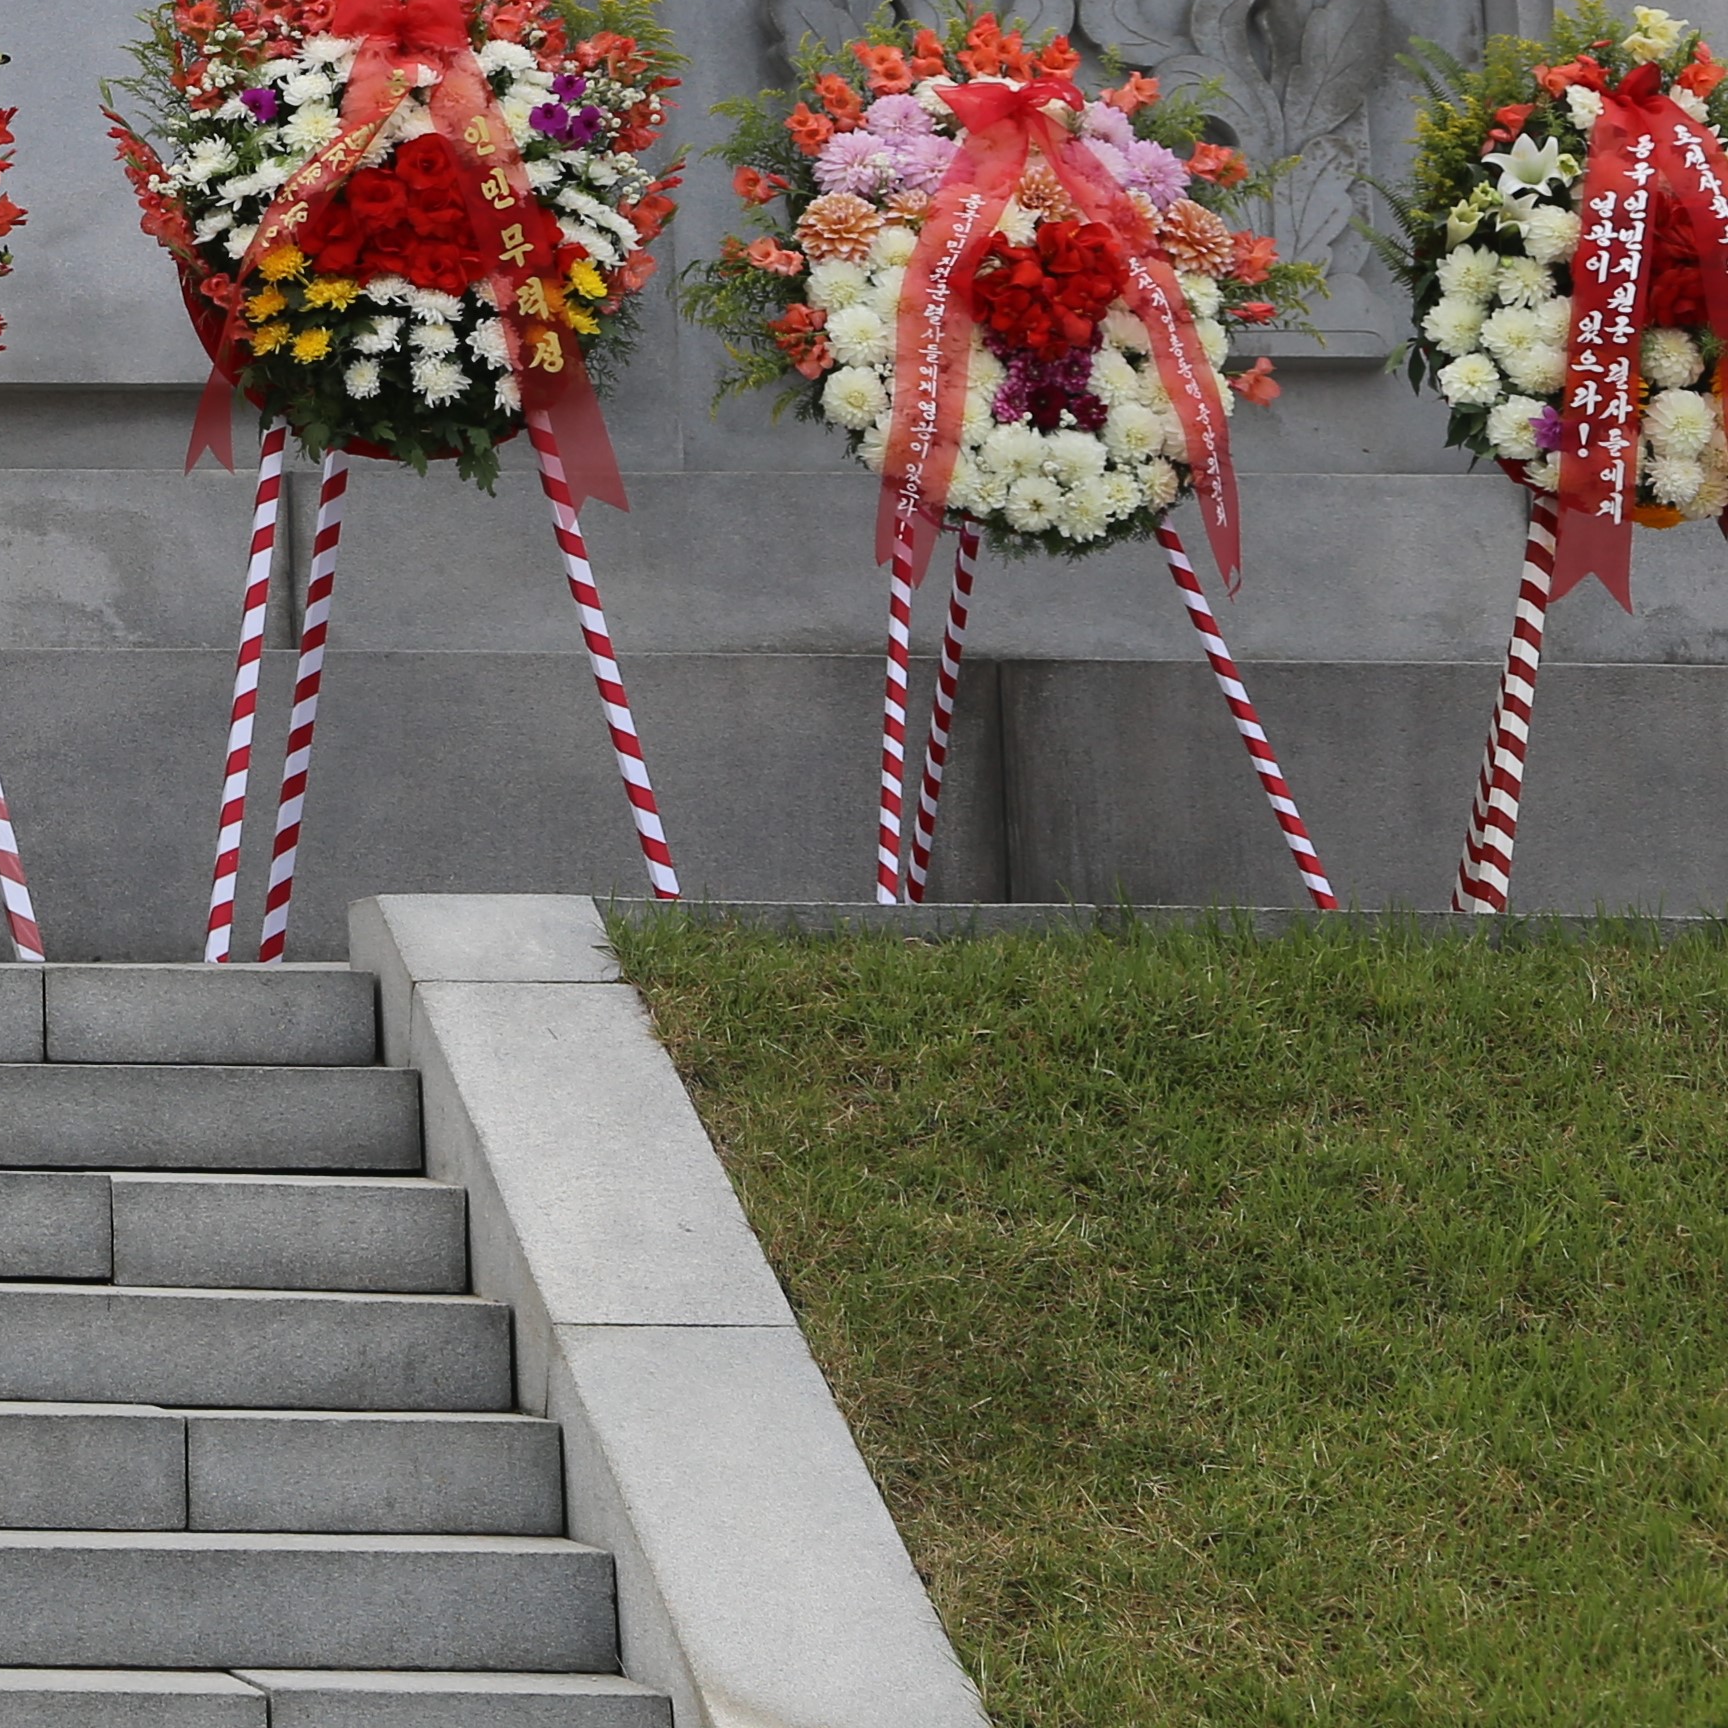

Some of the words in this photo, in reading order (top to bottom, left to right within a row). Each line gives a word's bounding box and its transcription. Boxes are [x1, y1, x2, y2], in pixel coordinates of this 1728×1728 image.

[463, 114, 565, 374] 인민무력성
[1582, 190, 1619, 285] 영광이
[1606, 133, 1657, 346] 중국인민지원군
[1570, 309, 1605, 460] 있으라!
[1595, 355, 1633, 525] 렬사들에게
